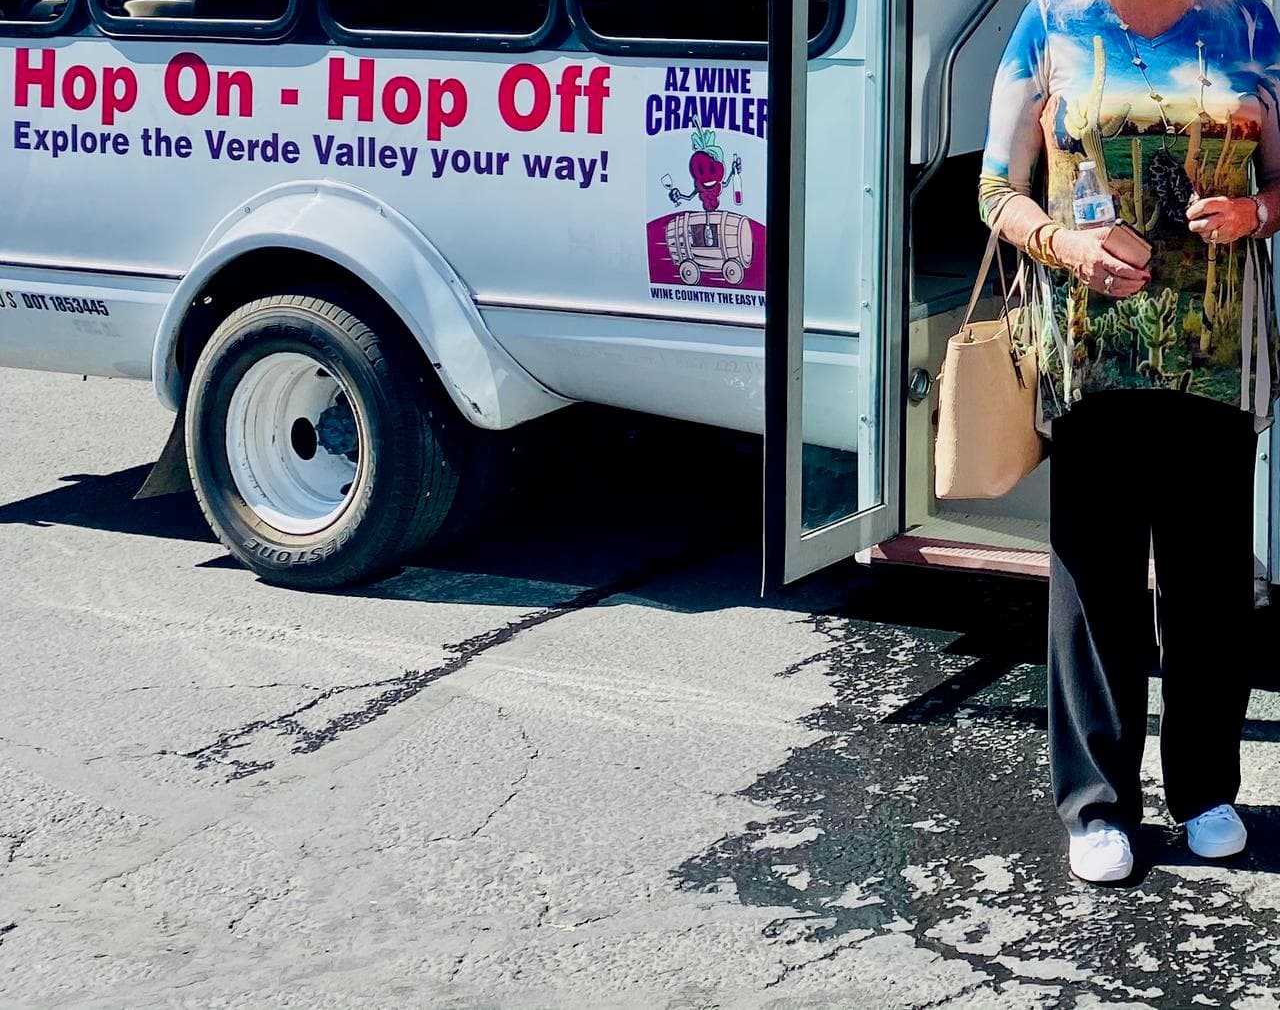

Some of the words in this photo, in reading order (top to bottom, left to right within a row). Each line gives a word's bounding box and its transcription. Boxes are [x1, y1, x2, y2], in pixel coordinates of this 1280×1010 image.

[664, 66, 690, 92] AZ
[694, 67, 751, 94] WINE
[14, 48, 138, 125] Hop
[164, 52, 253, 117] On
[281, 89, 299, 105] -
[328, 58, 468, 141] Hop
[498, 64, 611, 134] Off
[14, 121, 130, 157] Explore
[140, 128, 193, 159] the
[205, 130, 301, 164] Verde
[312, 135, 418, 177] Valley
[431, 149, 510, 179] your
[523, 150, 609, 189] way!
[21, 293, 50, 311] DOT
[50, 297, 110, 316] 1853445
[650, 287, 673, 300] WINE
[675, 289, 715, 303] COUNTRY
[717, 292, 733, 304] THE
[735, 294, 757, 306] EASY
